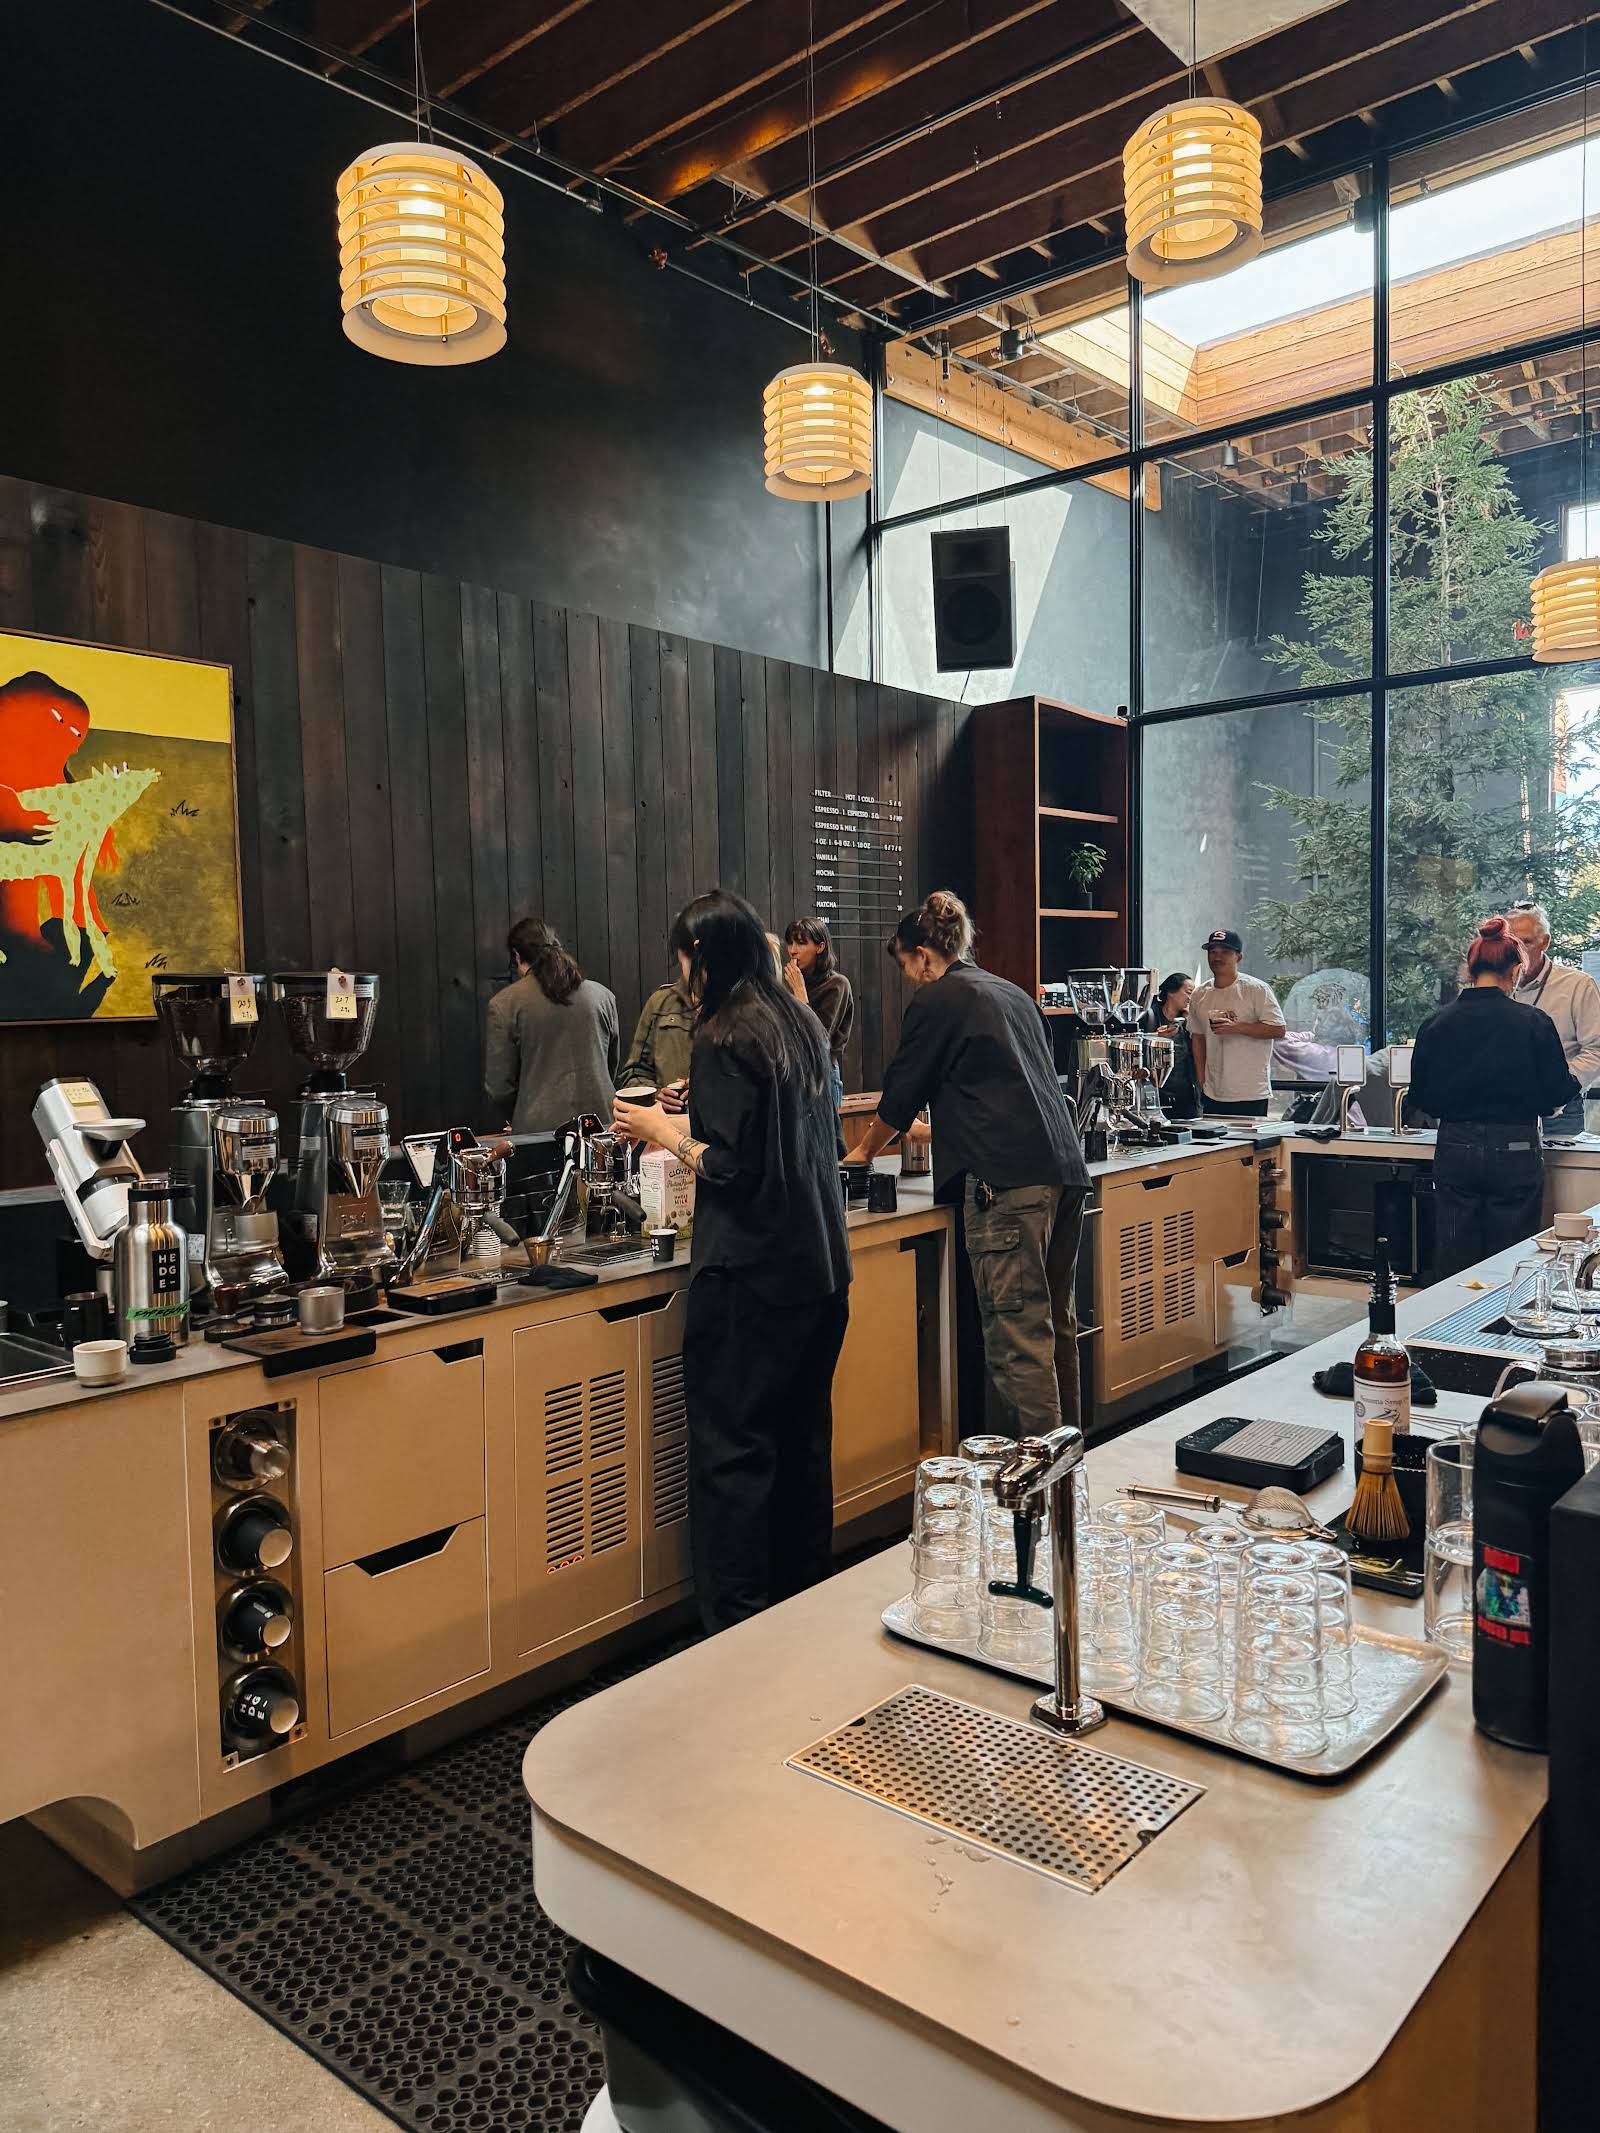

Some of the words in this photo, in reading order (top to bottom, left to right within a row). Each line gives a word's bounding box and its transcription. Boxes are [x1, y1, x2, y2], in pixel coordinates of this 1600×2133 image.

[815, 789, 832, 798] FILTER
[815, 806, 840, 815] ESPRESSO
[847, 810, 869, 818] ESPRESSO
[815, 822, 840, 831] ESPRESSO
[815, 853, 838, 862] VANILLA
[815, 869, 835, 877] MOCHA
[668, 1167, 692, 1178] CLOVER
